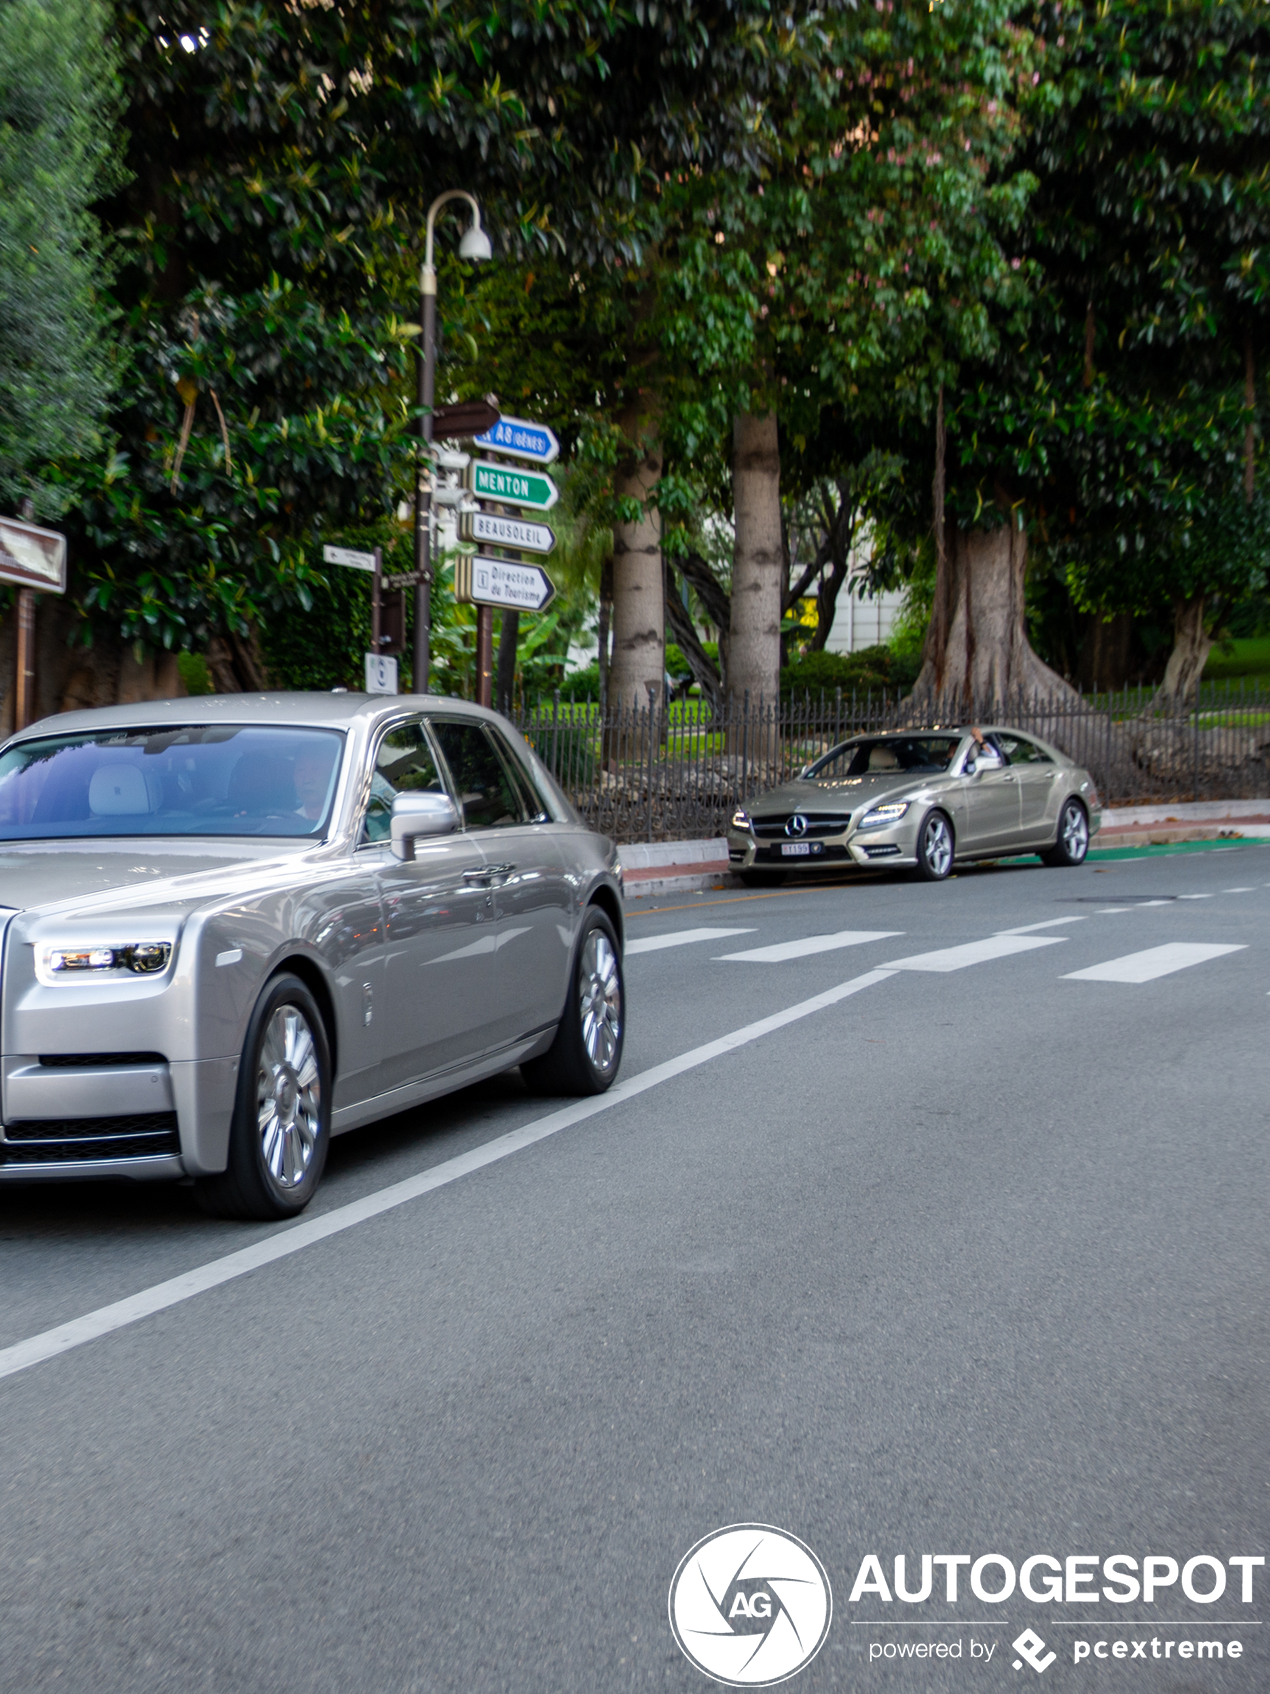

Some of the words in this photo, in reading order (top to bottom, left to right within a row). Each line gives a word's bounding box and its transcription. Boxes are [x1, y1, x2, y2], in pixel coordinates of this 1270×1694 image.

[478, 470, 529, 497] MENTON
[478, 518, 542, 545] BEAUSOLEIL
[492, 566, 535, 586] Direction
[504, 584, 541, 602] Tourisme
